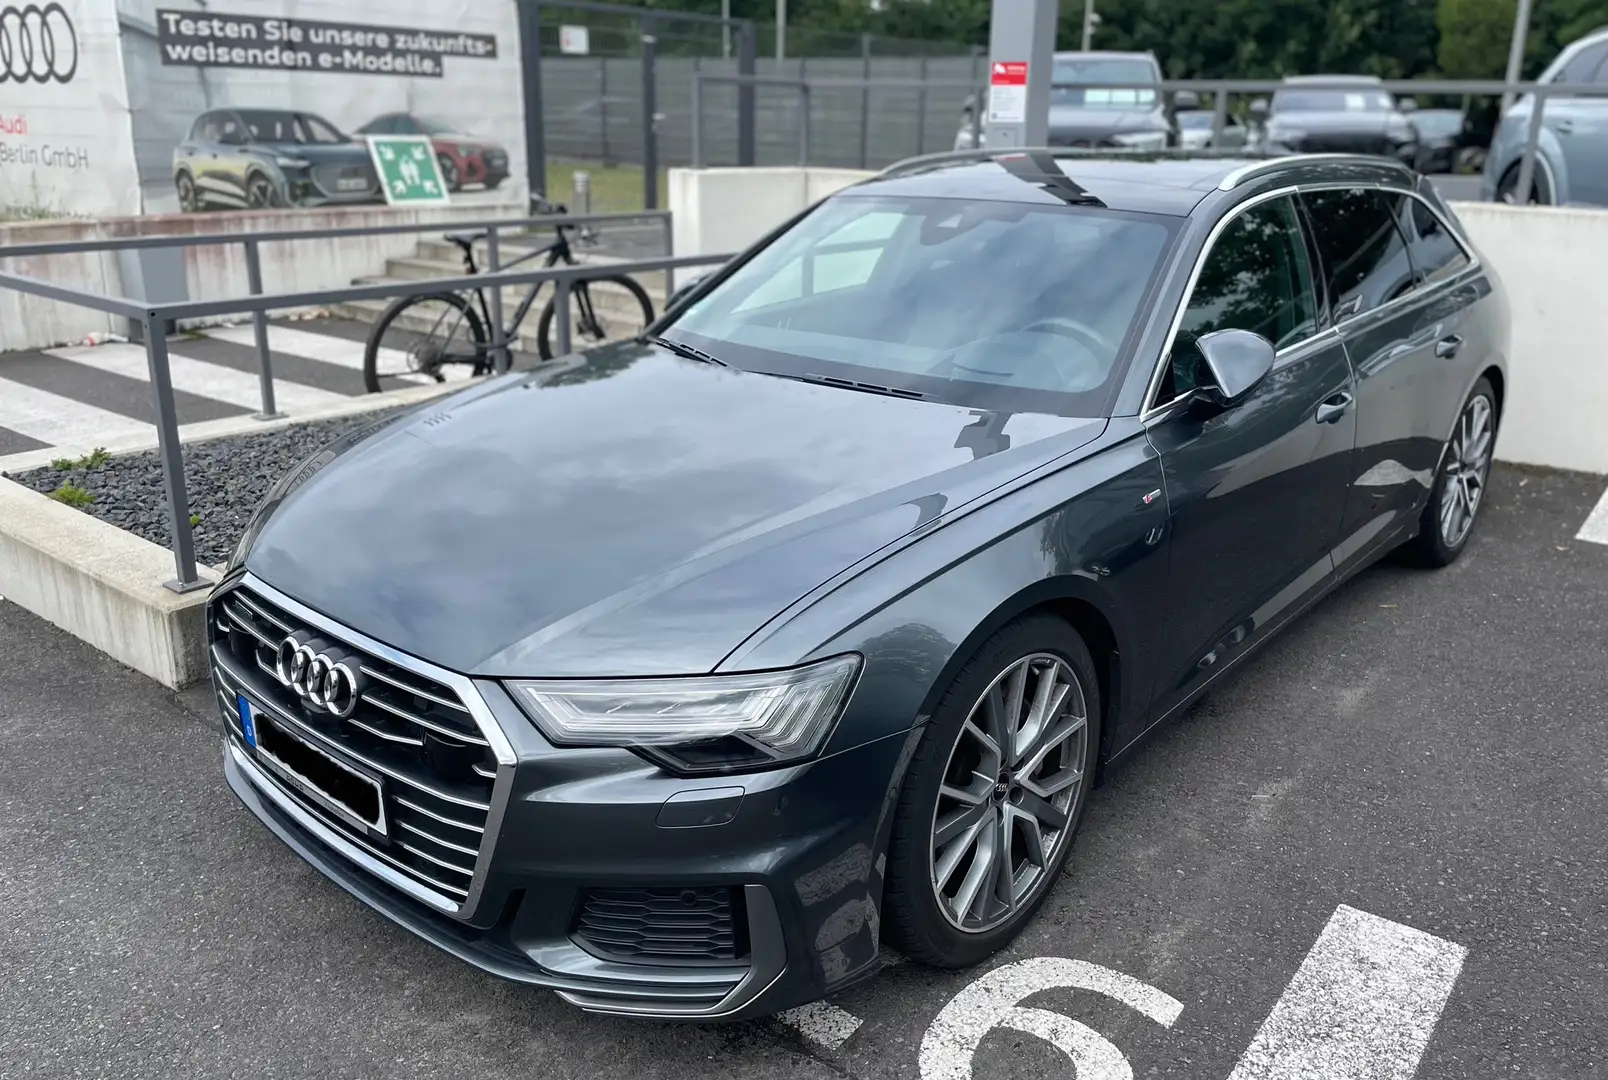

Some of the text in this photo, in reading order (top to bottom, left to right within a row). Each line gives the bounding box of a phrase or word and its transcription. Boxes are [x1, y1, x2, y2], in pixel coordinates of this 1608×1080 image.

[162, 13, 494, 56] Testen Sie unsere zukunfts-
[165, 41, 442, 74] weisenden e-Modelle.
[0, 141, 89, 170] Berlin GmbH
[246, 724, 253, 737] D
[919, 957, 1185, 1080] 6
